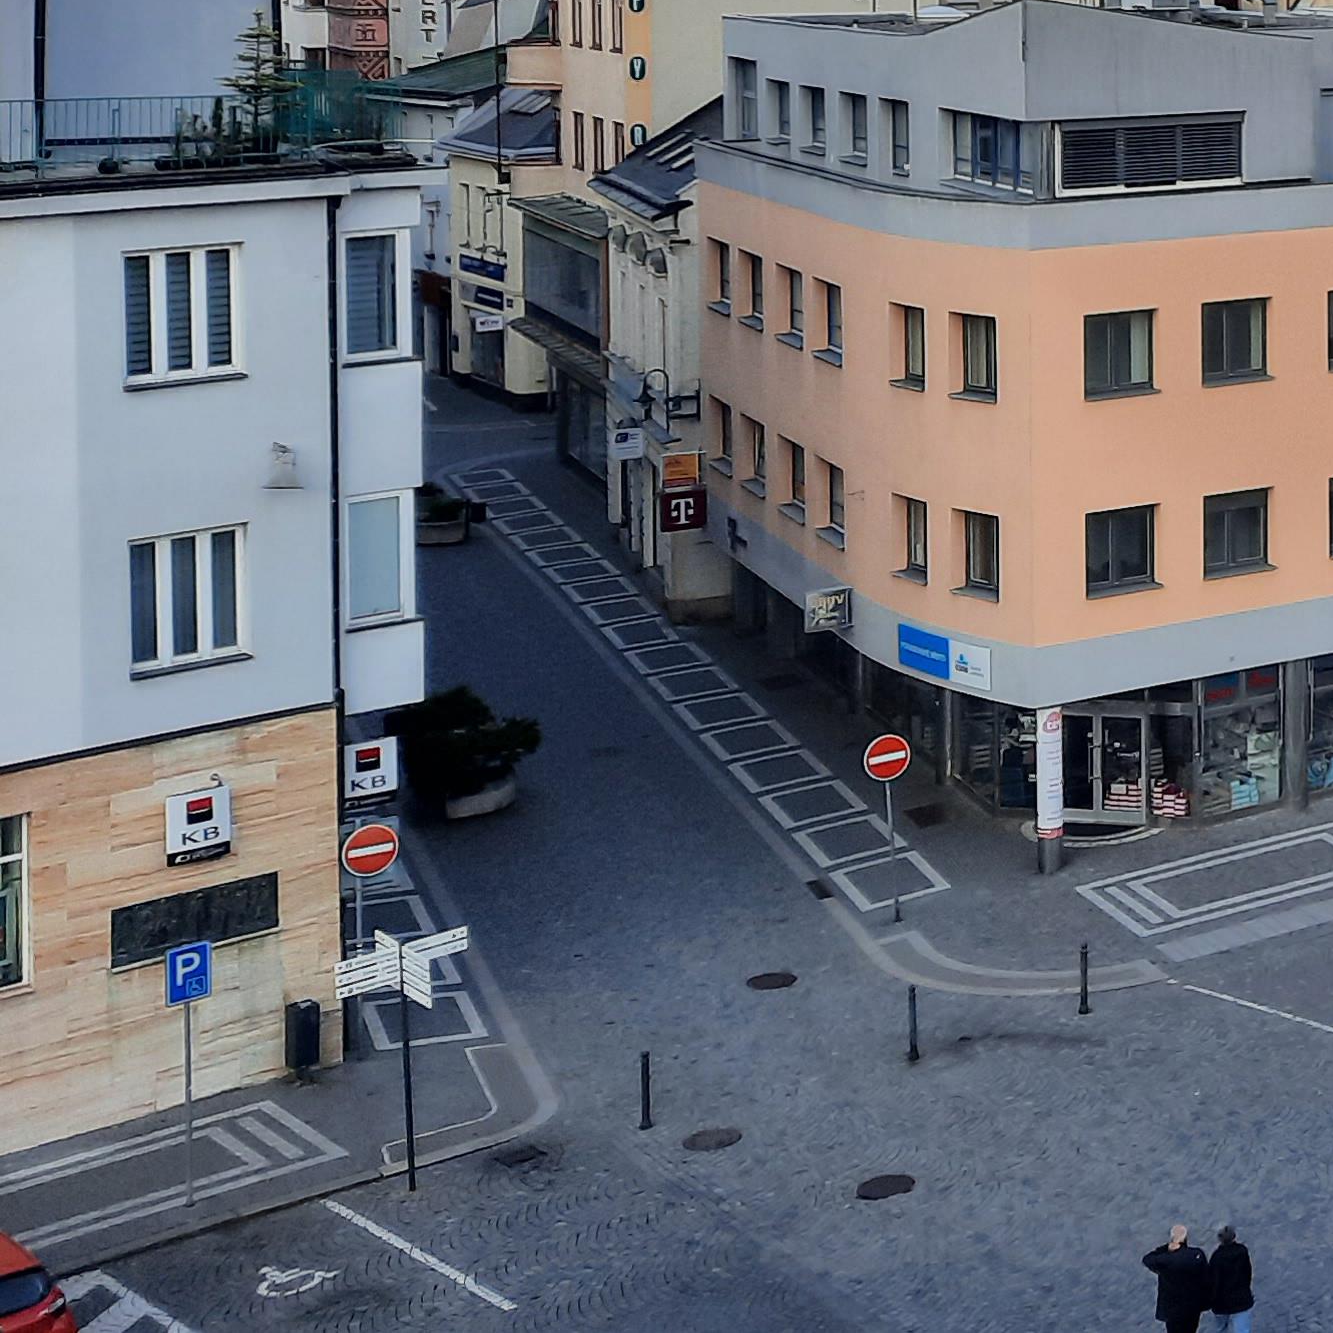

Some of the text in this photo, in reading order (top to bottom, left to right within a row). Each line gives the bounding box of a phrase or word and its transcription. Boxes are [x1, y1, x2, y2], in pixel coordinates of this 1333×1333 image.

[350, 775, 387, 793] KB
[181, 825, 221, 847] KB
[175, 952, 201, 987] P
